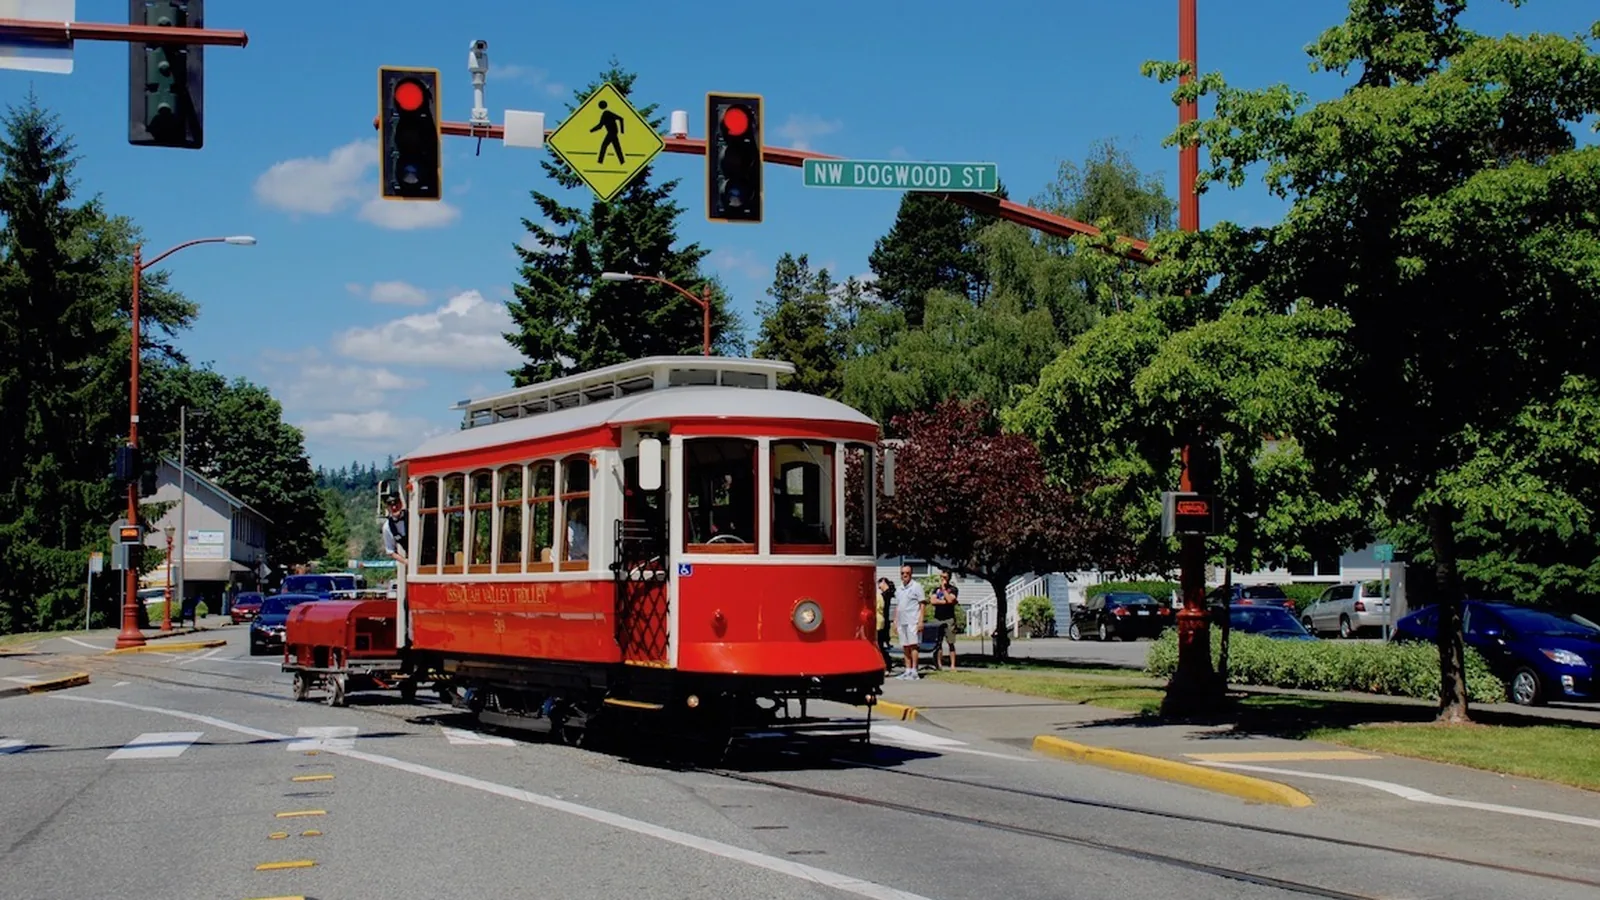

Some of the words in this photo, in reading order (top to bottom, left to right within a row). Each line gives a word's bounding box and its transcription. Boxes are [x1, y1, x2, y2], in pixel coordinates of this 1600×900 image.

[814, 163, 843, 184] NW
[854, 164, 951, 187] DOGWOOD
[962, 166, 986, 188] ST
[481, 587, 511, 604] VALLEY
[513, 587, 548, 604] TROLLEY
